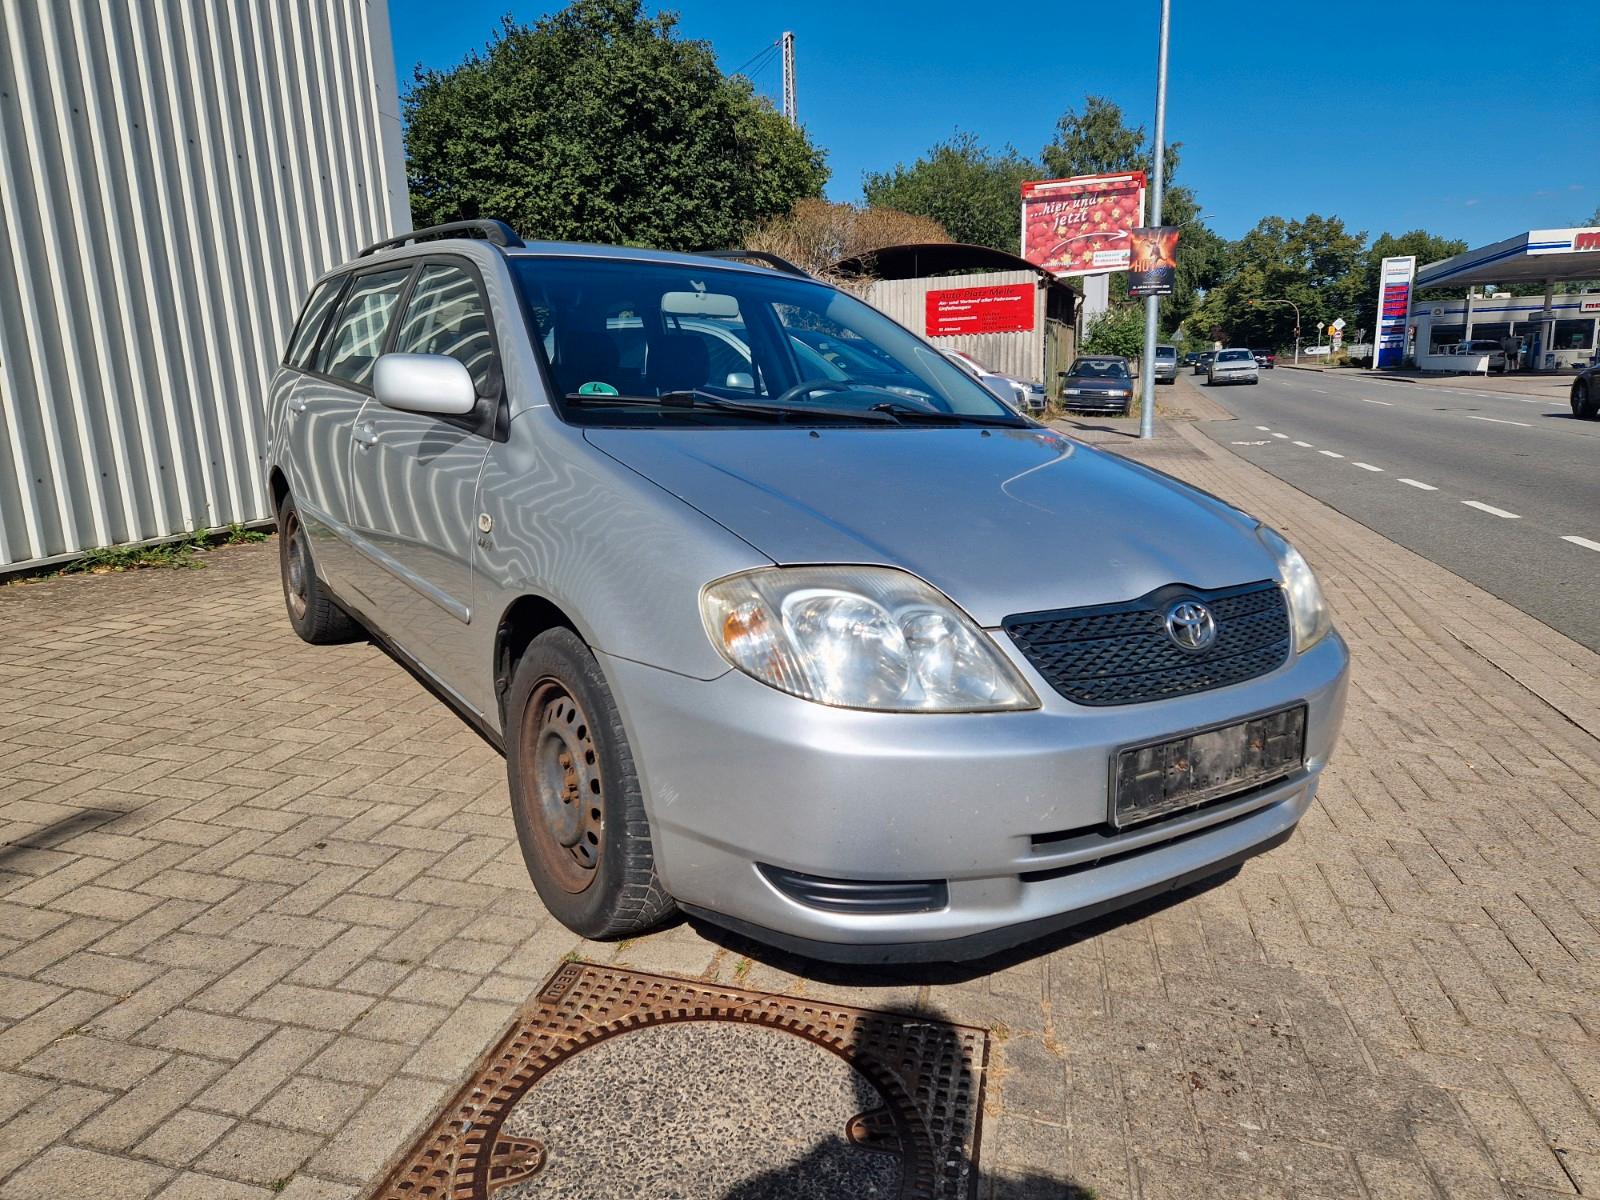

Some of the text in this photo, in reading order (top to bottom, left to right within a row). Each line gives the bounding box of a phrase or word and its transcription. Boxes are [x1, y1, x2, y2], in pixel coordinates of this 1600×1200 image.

[1072, 192, 1098, 209] und
[1052, 210, 1088, 232] jetzt
[547, 970, 577, 998] BEGU
